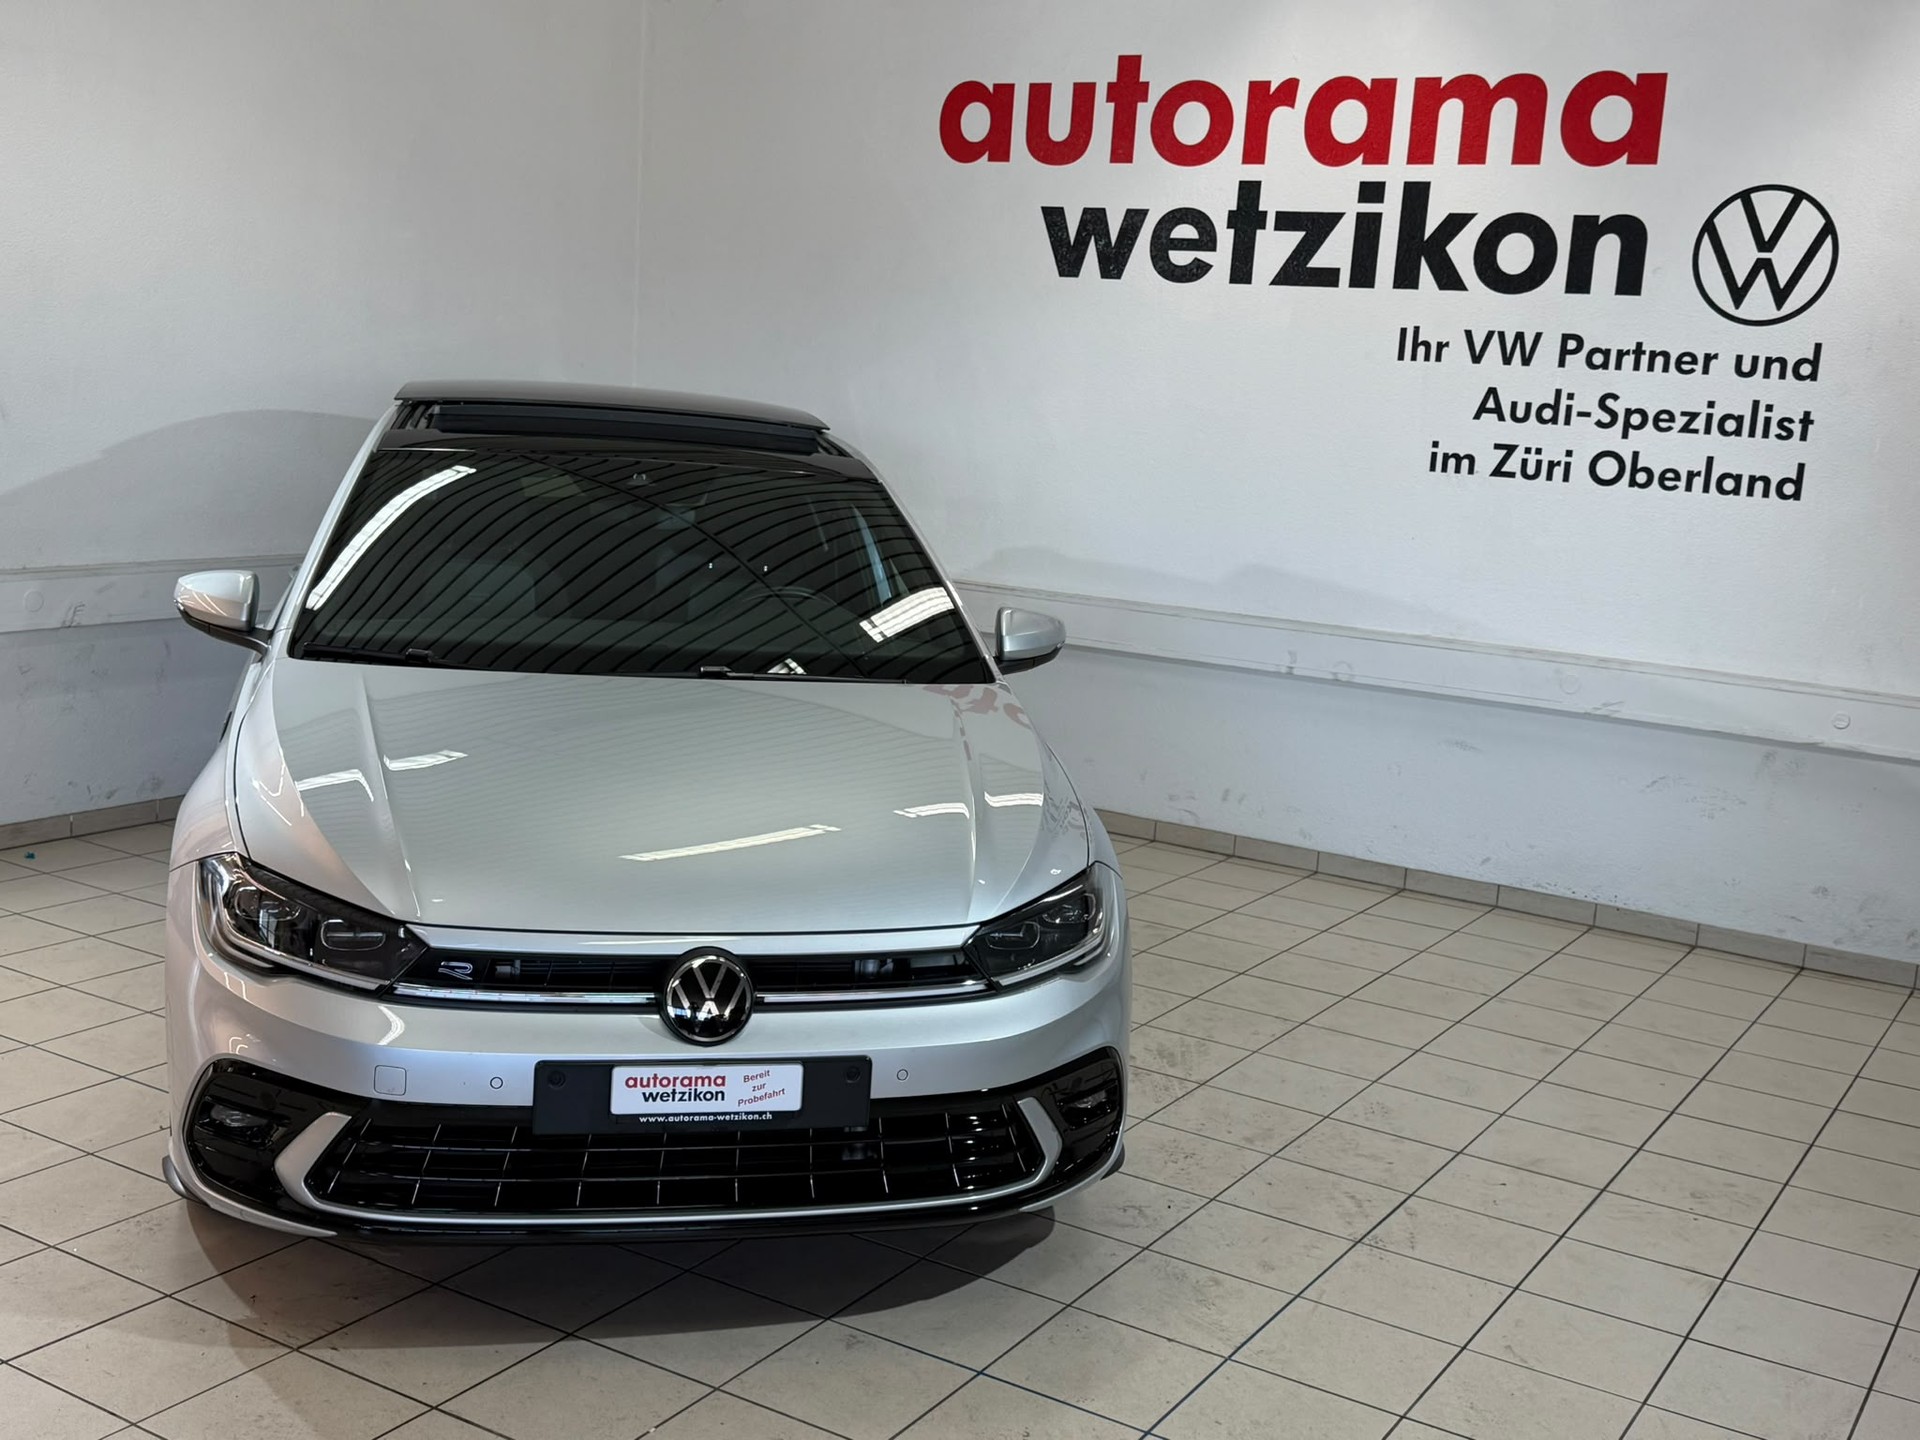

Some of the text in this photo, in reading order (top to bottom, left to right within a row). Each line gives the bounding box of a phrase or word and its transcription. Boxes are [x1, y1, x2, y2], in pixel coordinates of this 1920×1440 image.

[938, 54, 1669, 168] autorama
[1040, 180, 1648, 297] wetzikon
[1397, 325, 1823, 382] Ihr VW Partner und
[1472, 386, 1815, 442] Audi-Spezialist
[1429, 440, 1807, 502] im Züri Oberland
[625, 1073, 726, 1088] autorama
[743, 1070, 770, 1083] Bereit
[642, 1087, 725, 1103] wetzikon
[752, 1083, 767, 1092] zur
[738, 1088, 785, 1107] Probefahrt
[639, 1112, 773, 1123] www.autorama-wetzikon.ch
